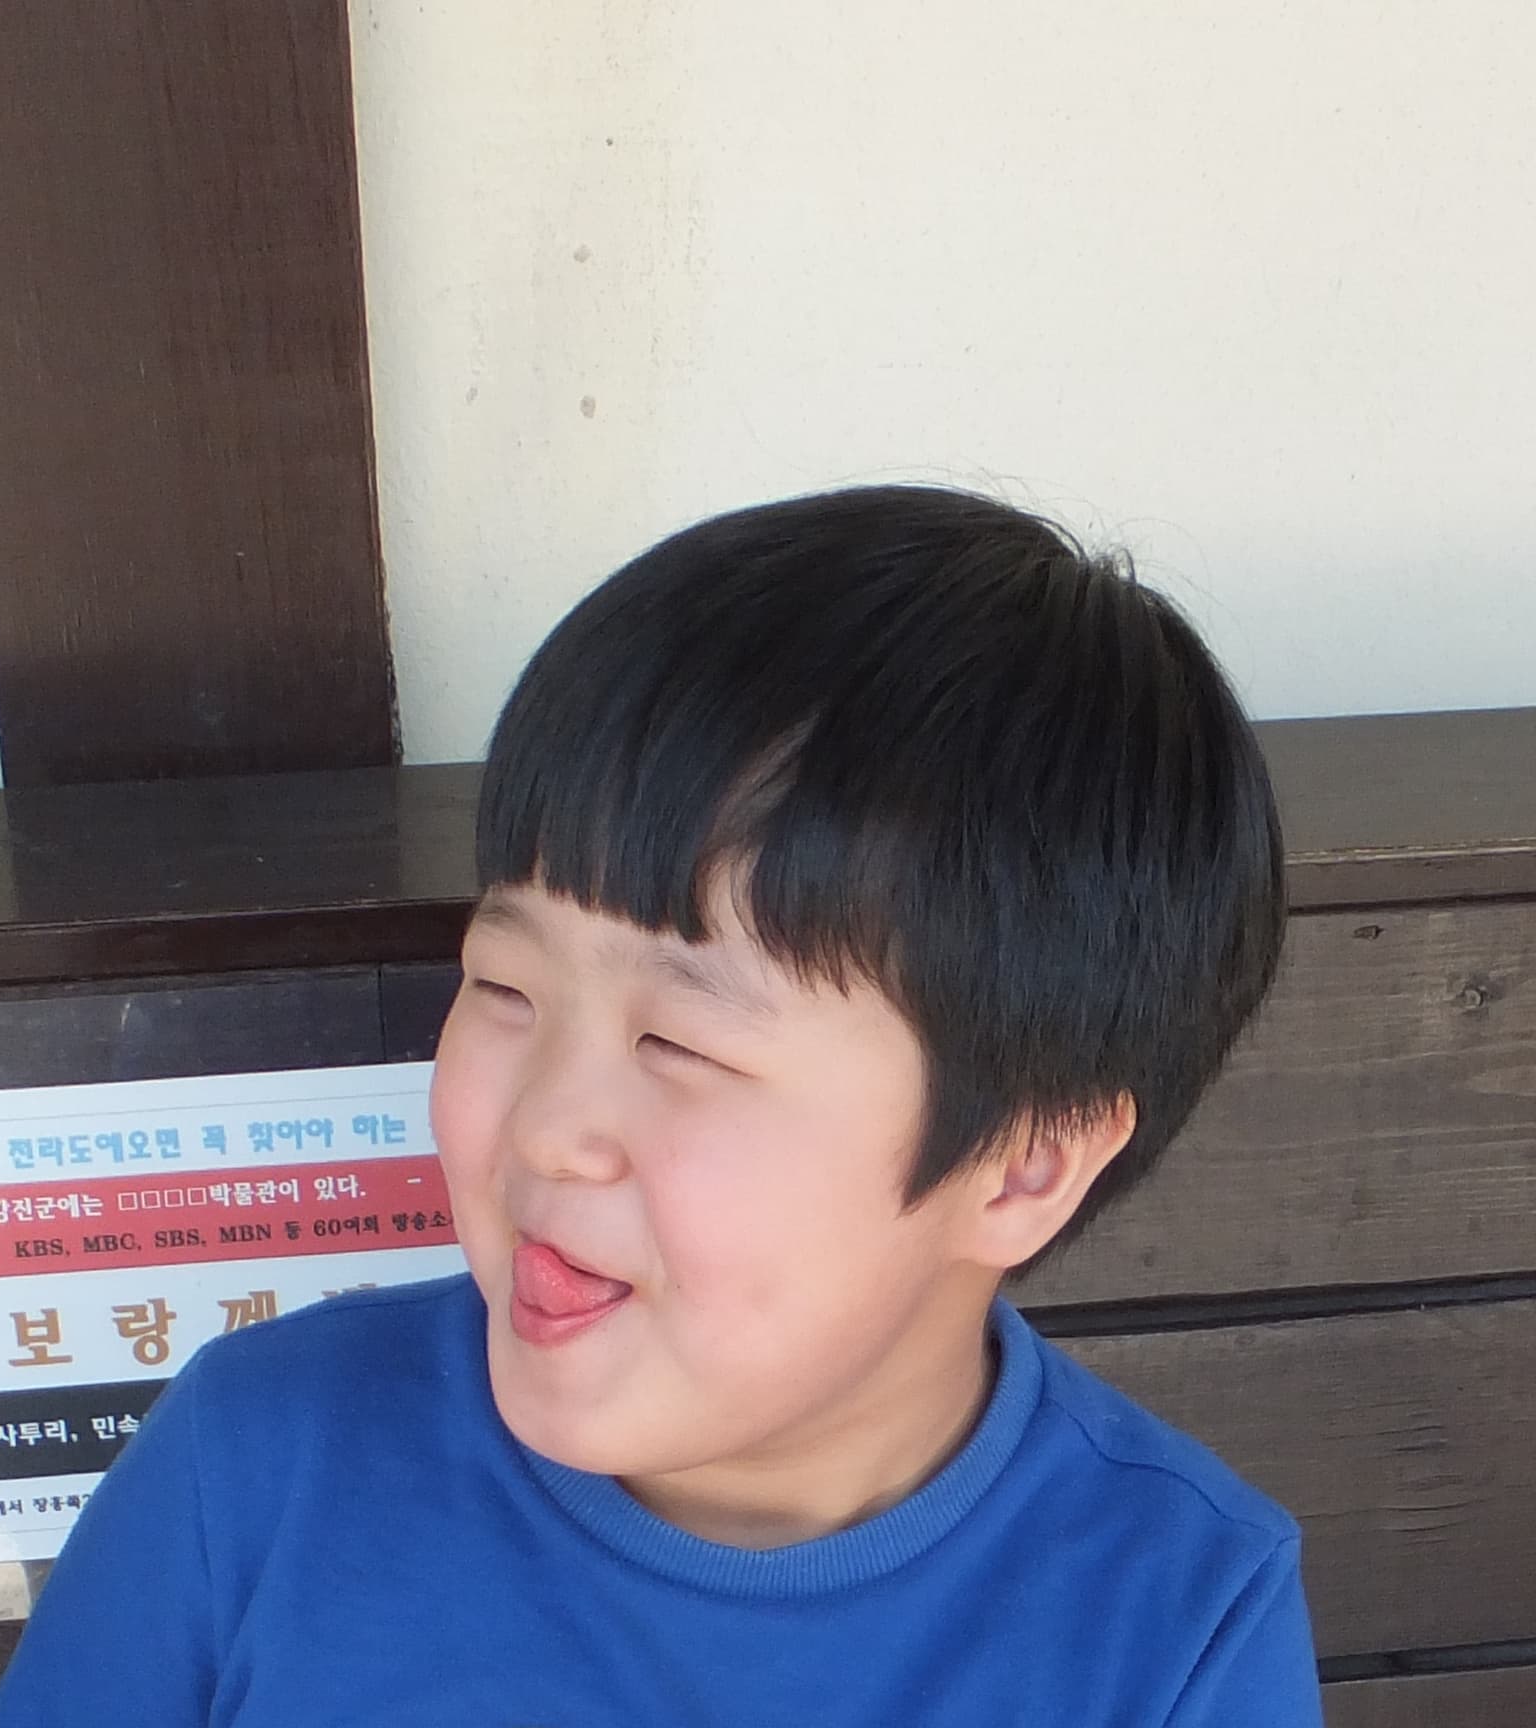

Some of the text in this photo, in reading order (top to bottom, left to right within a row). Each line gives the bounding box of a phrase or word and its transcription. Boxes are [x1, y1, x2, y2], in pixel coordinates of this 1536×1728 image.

[201, 1125, 227, 1155] 꼭
[247, 1115, 334, 1152] 찾아야
[352, 1113, 407, 1145] 하는
[314, 1174, 366, 1200] 있다.
[219, 1223, 272, 1244] MBN
[392, 1210, 453, 1233] 방송소
